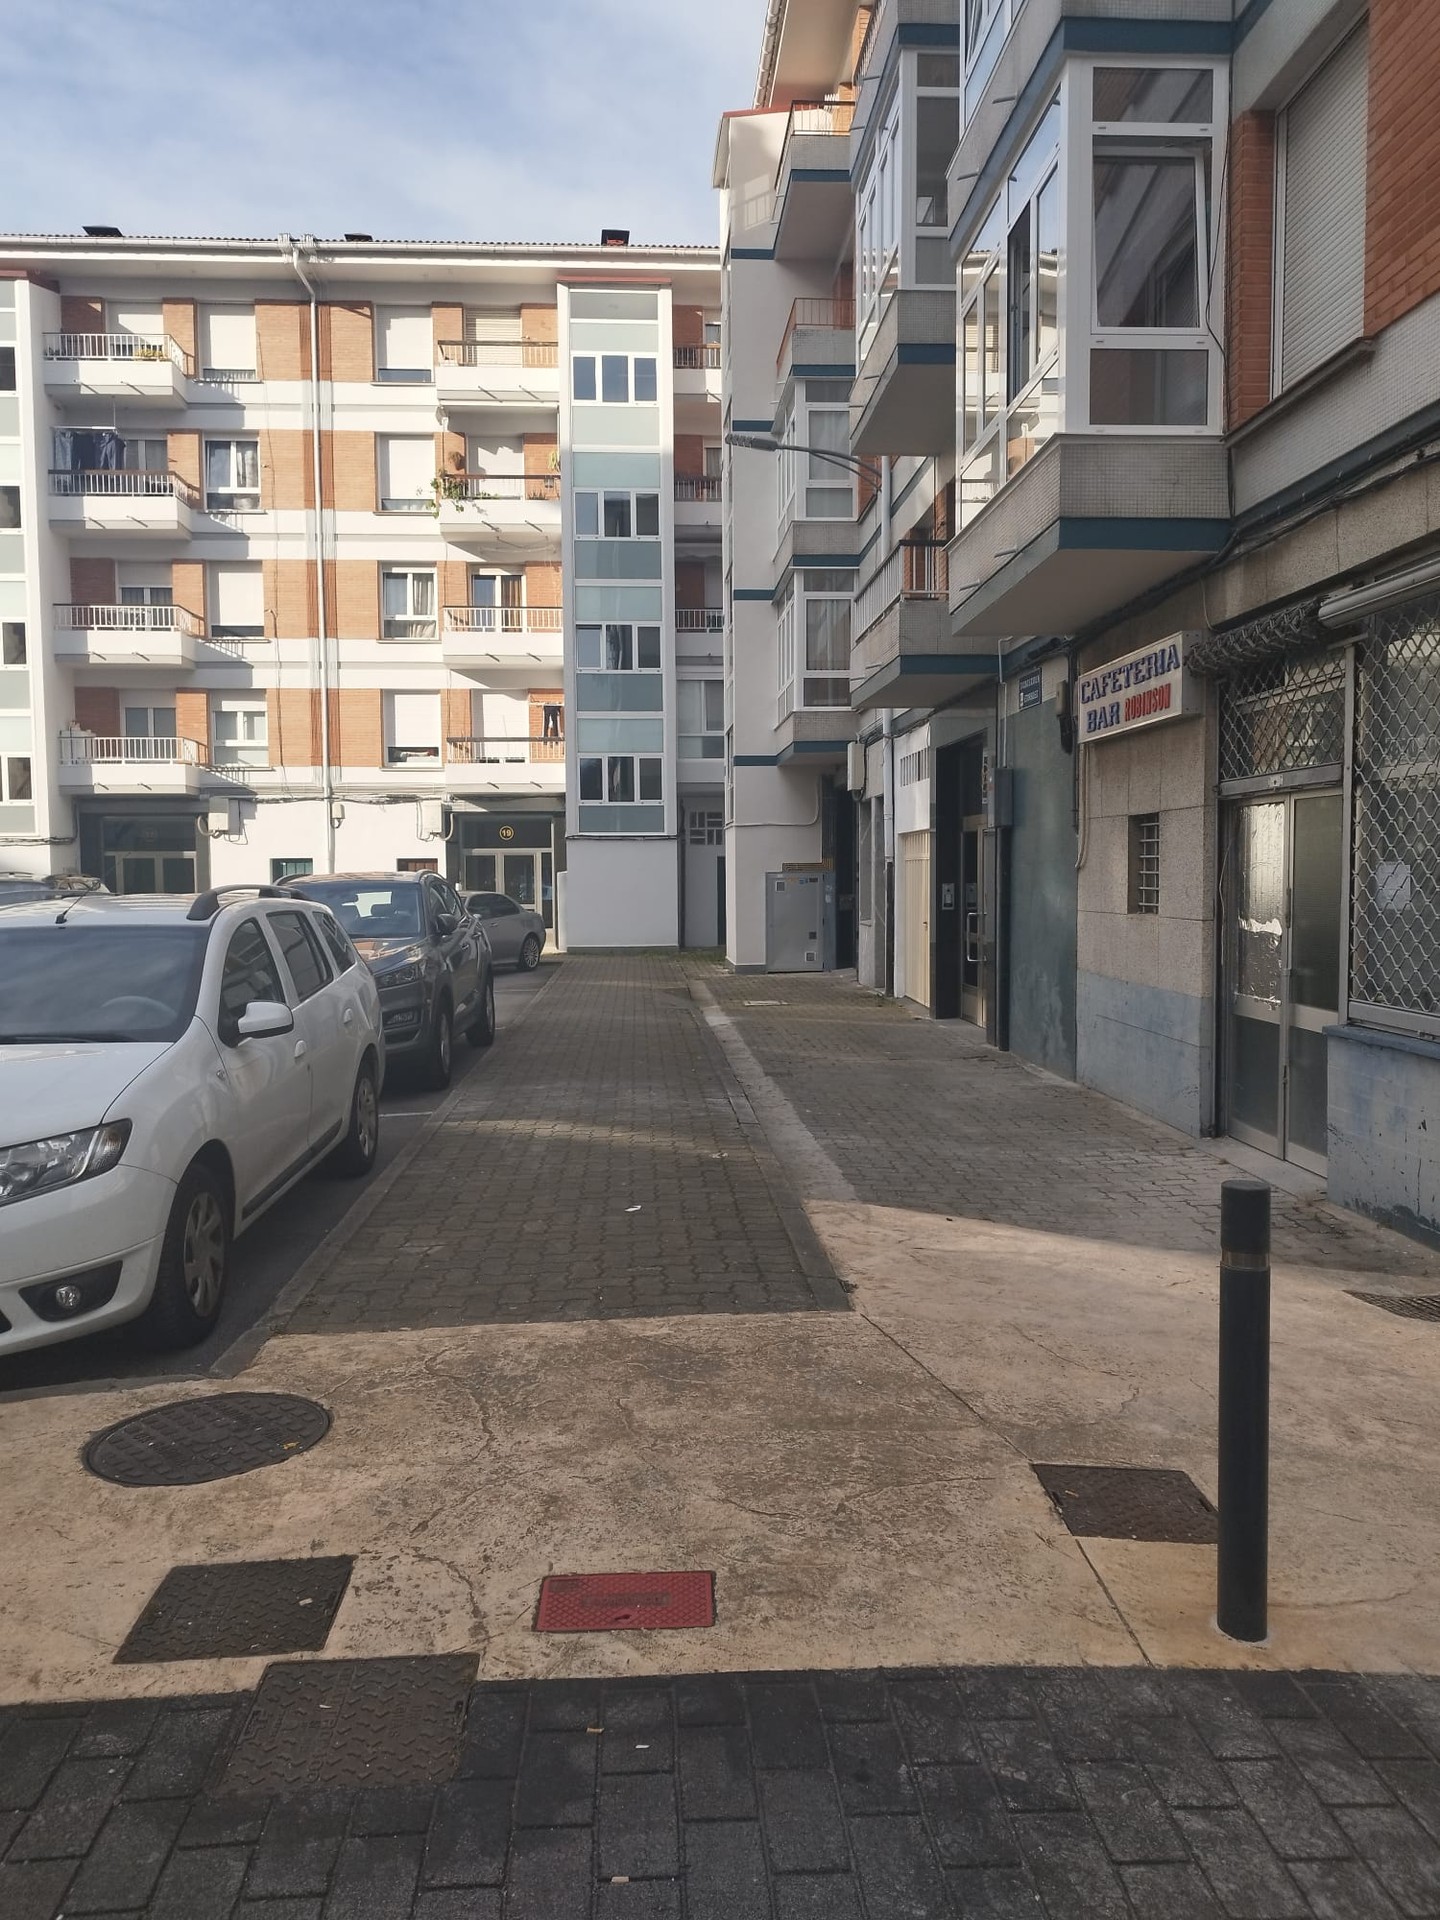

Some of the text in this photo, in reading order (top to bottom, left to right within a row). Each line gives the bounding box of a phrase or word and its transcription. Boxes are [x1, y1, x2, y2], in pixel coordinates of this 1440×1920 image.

[1081, 644, 1180, 704] CAFETERIA
[1086, 683, 1171, 733] BAR ROBINSON
[501, 829, 512, 837] 19
